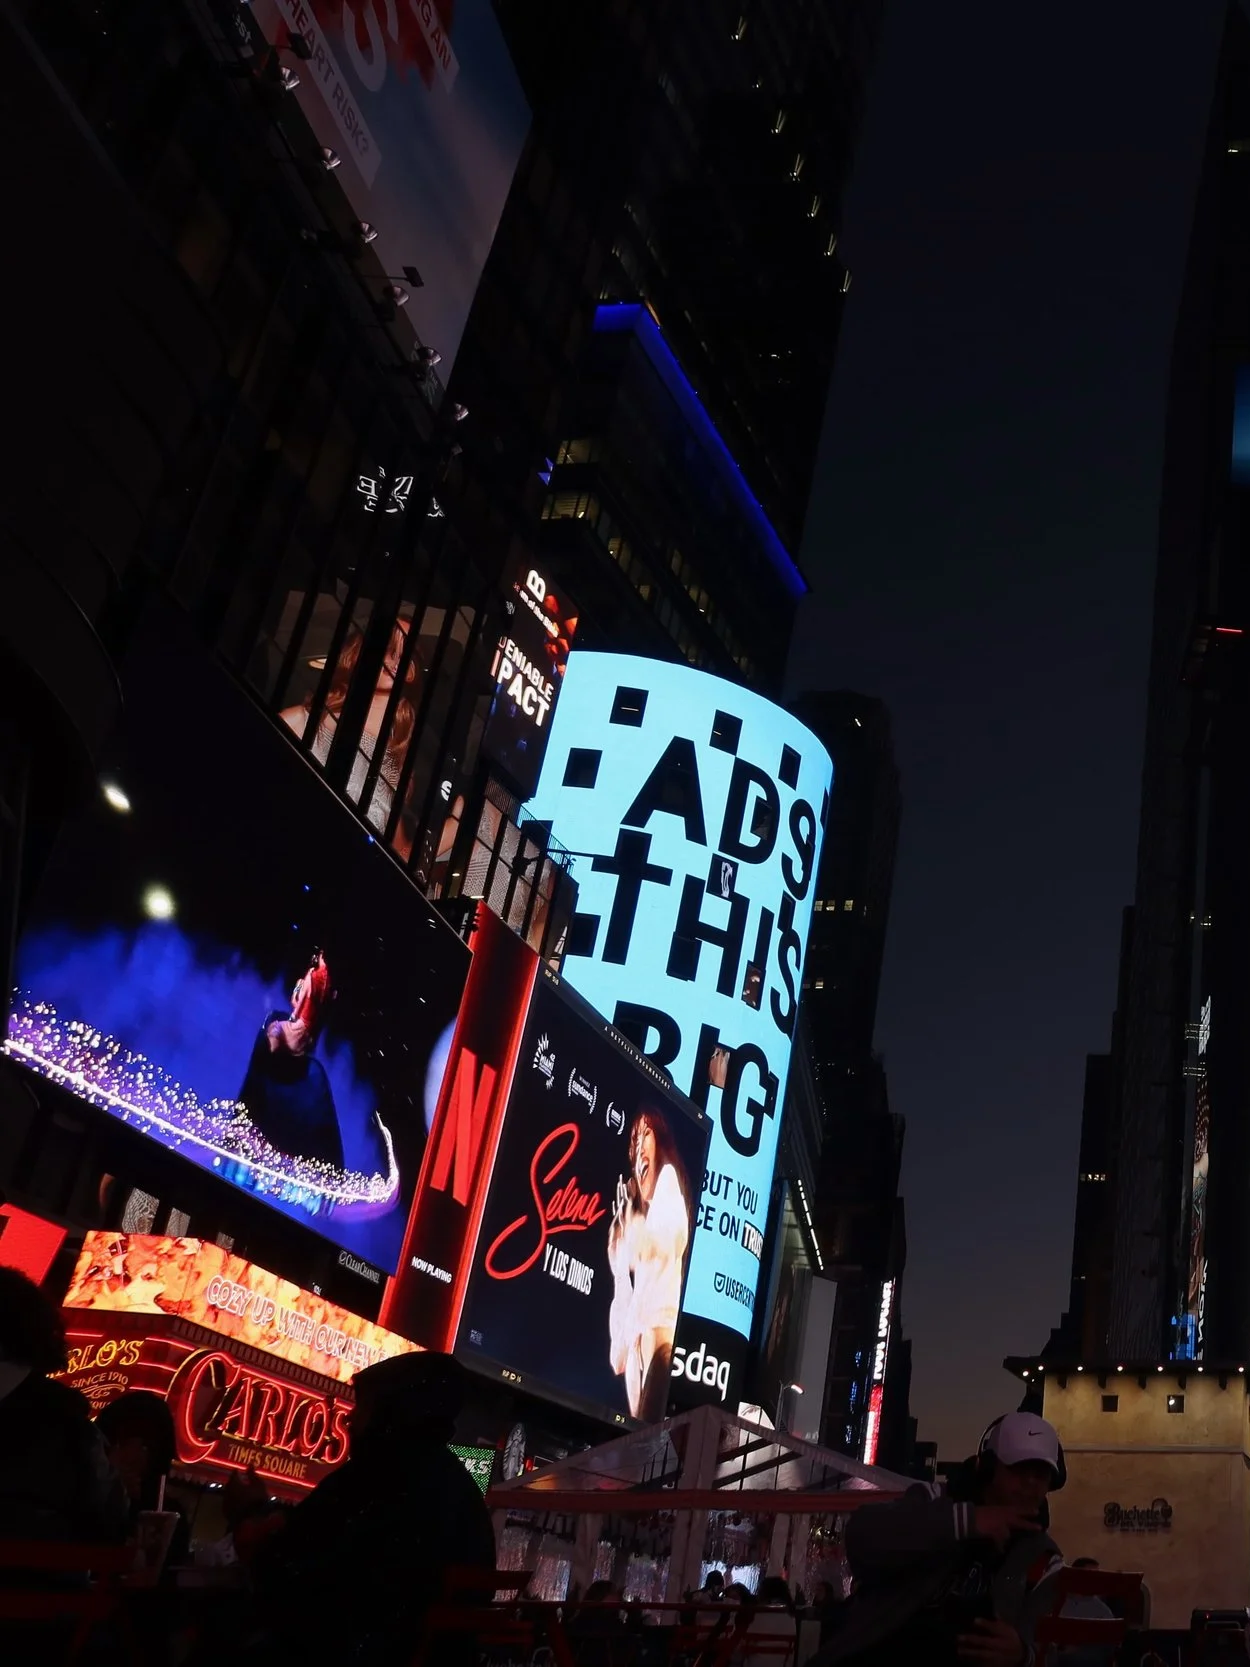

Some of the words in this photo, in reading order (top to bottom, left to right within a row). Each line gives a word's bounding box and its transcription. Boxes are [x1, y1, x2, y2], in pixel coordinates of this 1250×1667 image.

[331, 84, 371, 157] RISK?
[620, 735, 816, 900] ADS
[634, 1053, 671, 1091] DOCUMENTARY
[572, 1080, 594, 1103] sundance
[485, 1123, 606, 1280] Selena
[737, 1181, 758, 1215] YOU
[719, 1211, 740, 1242] ON
[411, 1256, 428, 1272] NOW
[427, 1263, 453, 1284] PLAYING
[543, 1242, 553, 1272] Y
[549, 1247, 569, 1282] LOS
[567, 1257, 594, 1296] DINOS
[207, 1275, 253, 1317] COZY
[251, 1294, 276, 1326] UP
[277, 1306, 317, 1345] WITH
[315, 1324, 347, 1358] OUR
[66, 1339, 144, 1374] RLO'S
[70, 1372, 108, 1388] SINCE
[107, 1371, 129, 1386] 1910
[228, 1444, 262, 1466] TIMES
[262, 1453, 308, 1479] SQUARE
